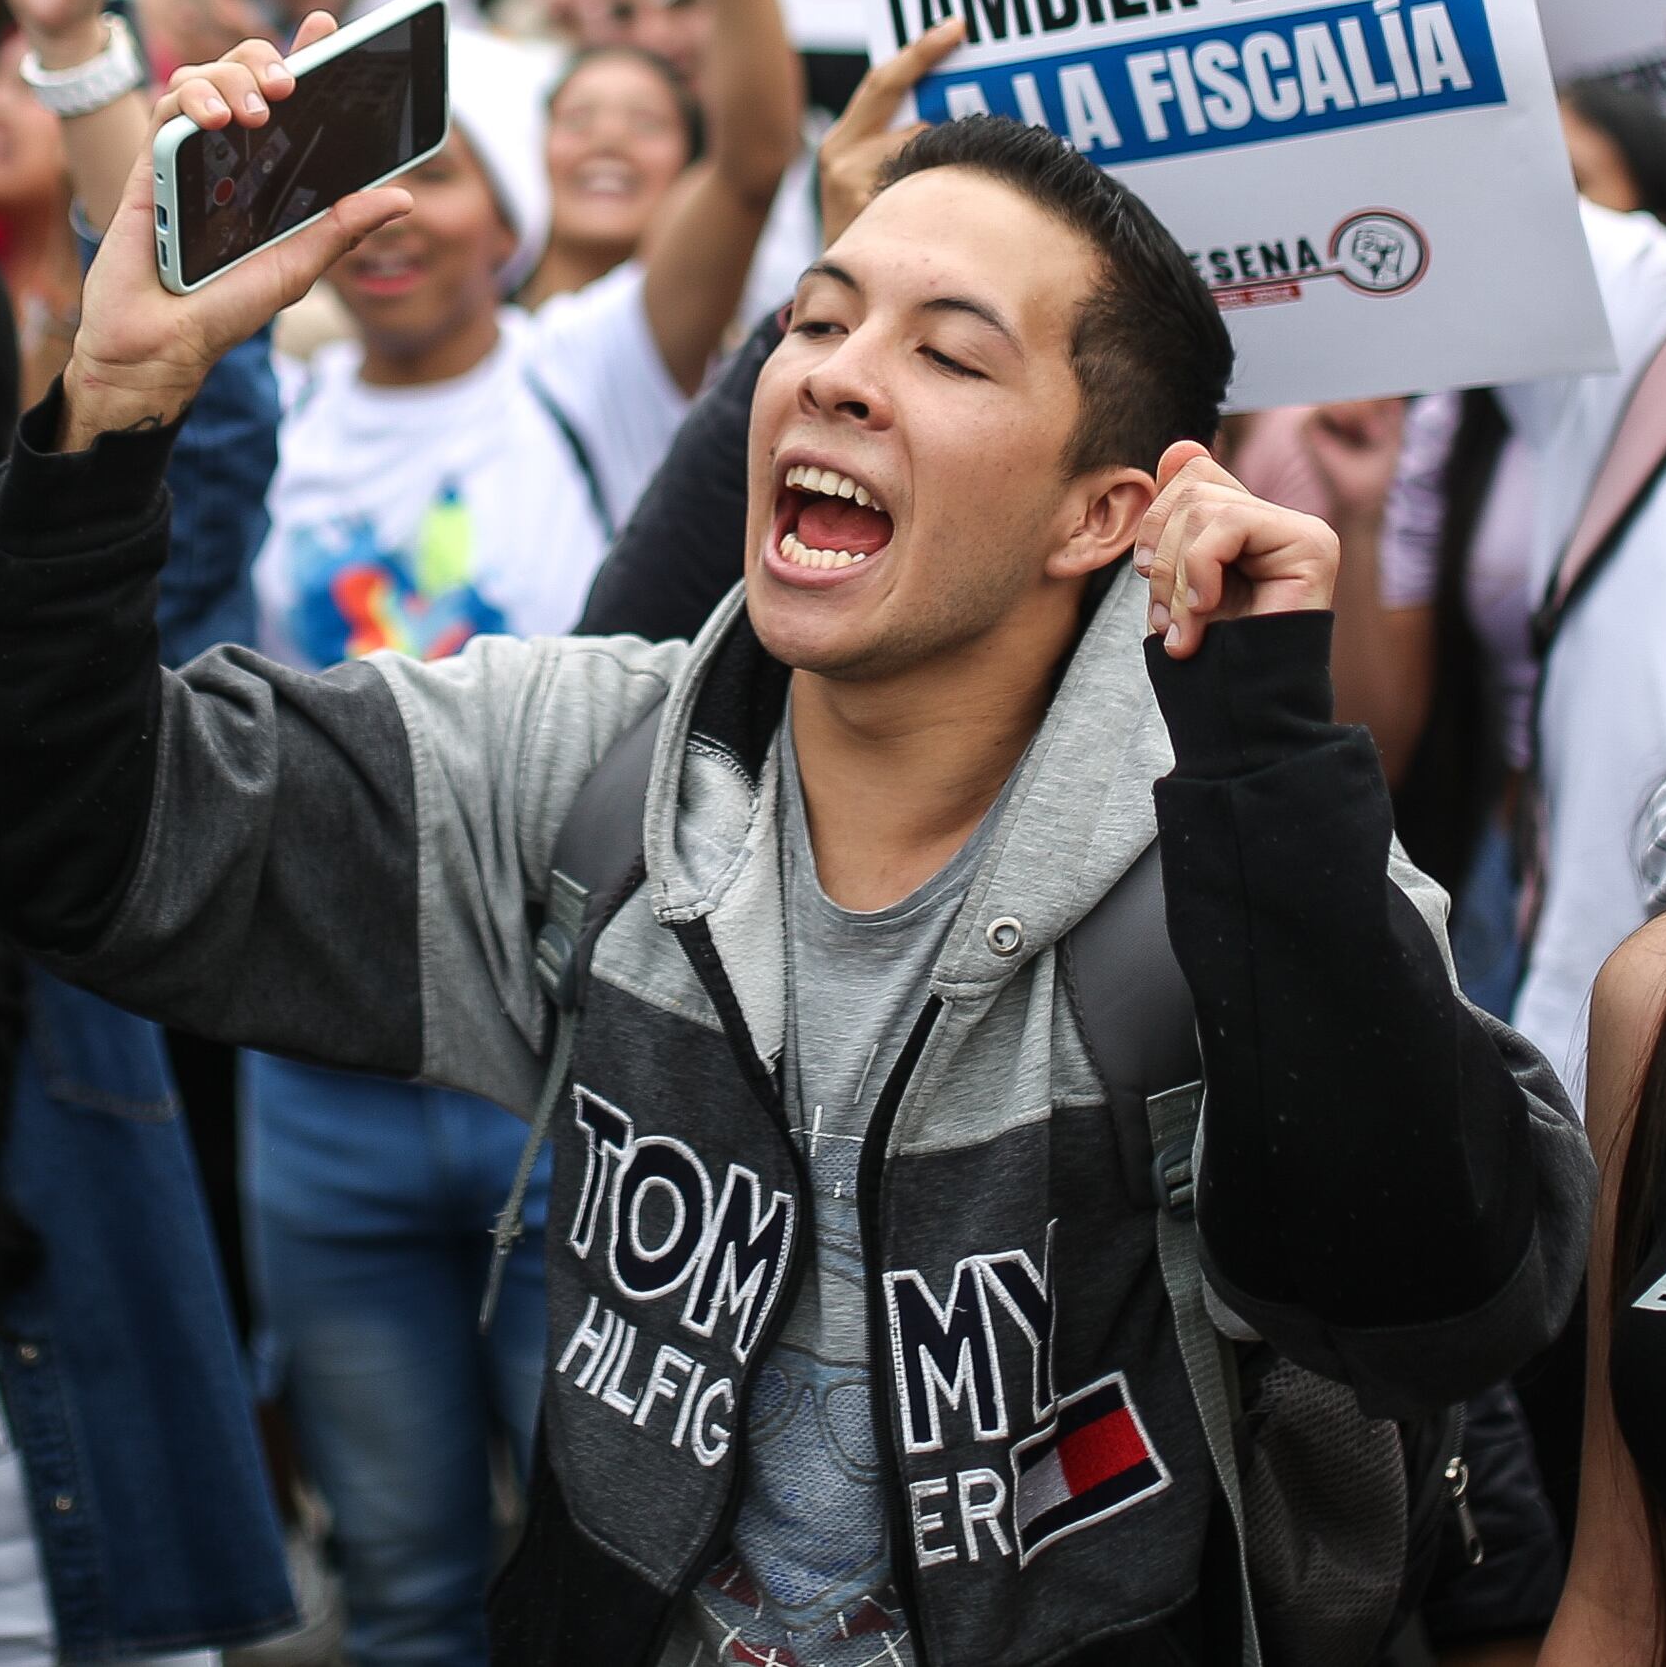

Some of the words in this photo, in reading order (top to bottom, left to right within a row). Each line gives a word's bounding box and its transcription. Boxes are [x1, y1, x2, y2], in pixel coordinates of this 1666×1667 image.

[1127, 0, 1471, 141] FISCALÍA
[571, 1085, 795, 1366] TOM
[884, 1219, 1057, 1453] MY
[556, 1297, 734, 1466] HILFIG
[910, 1469, 1012, 1567] ER
